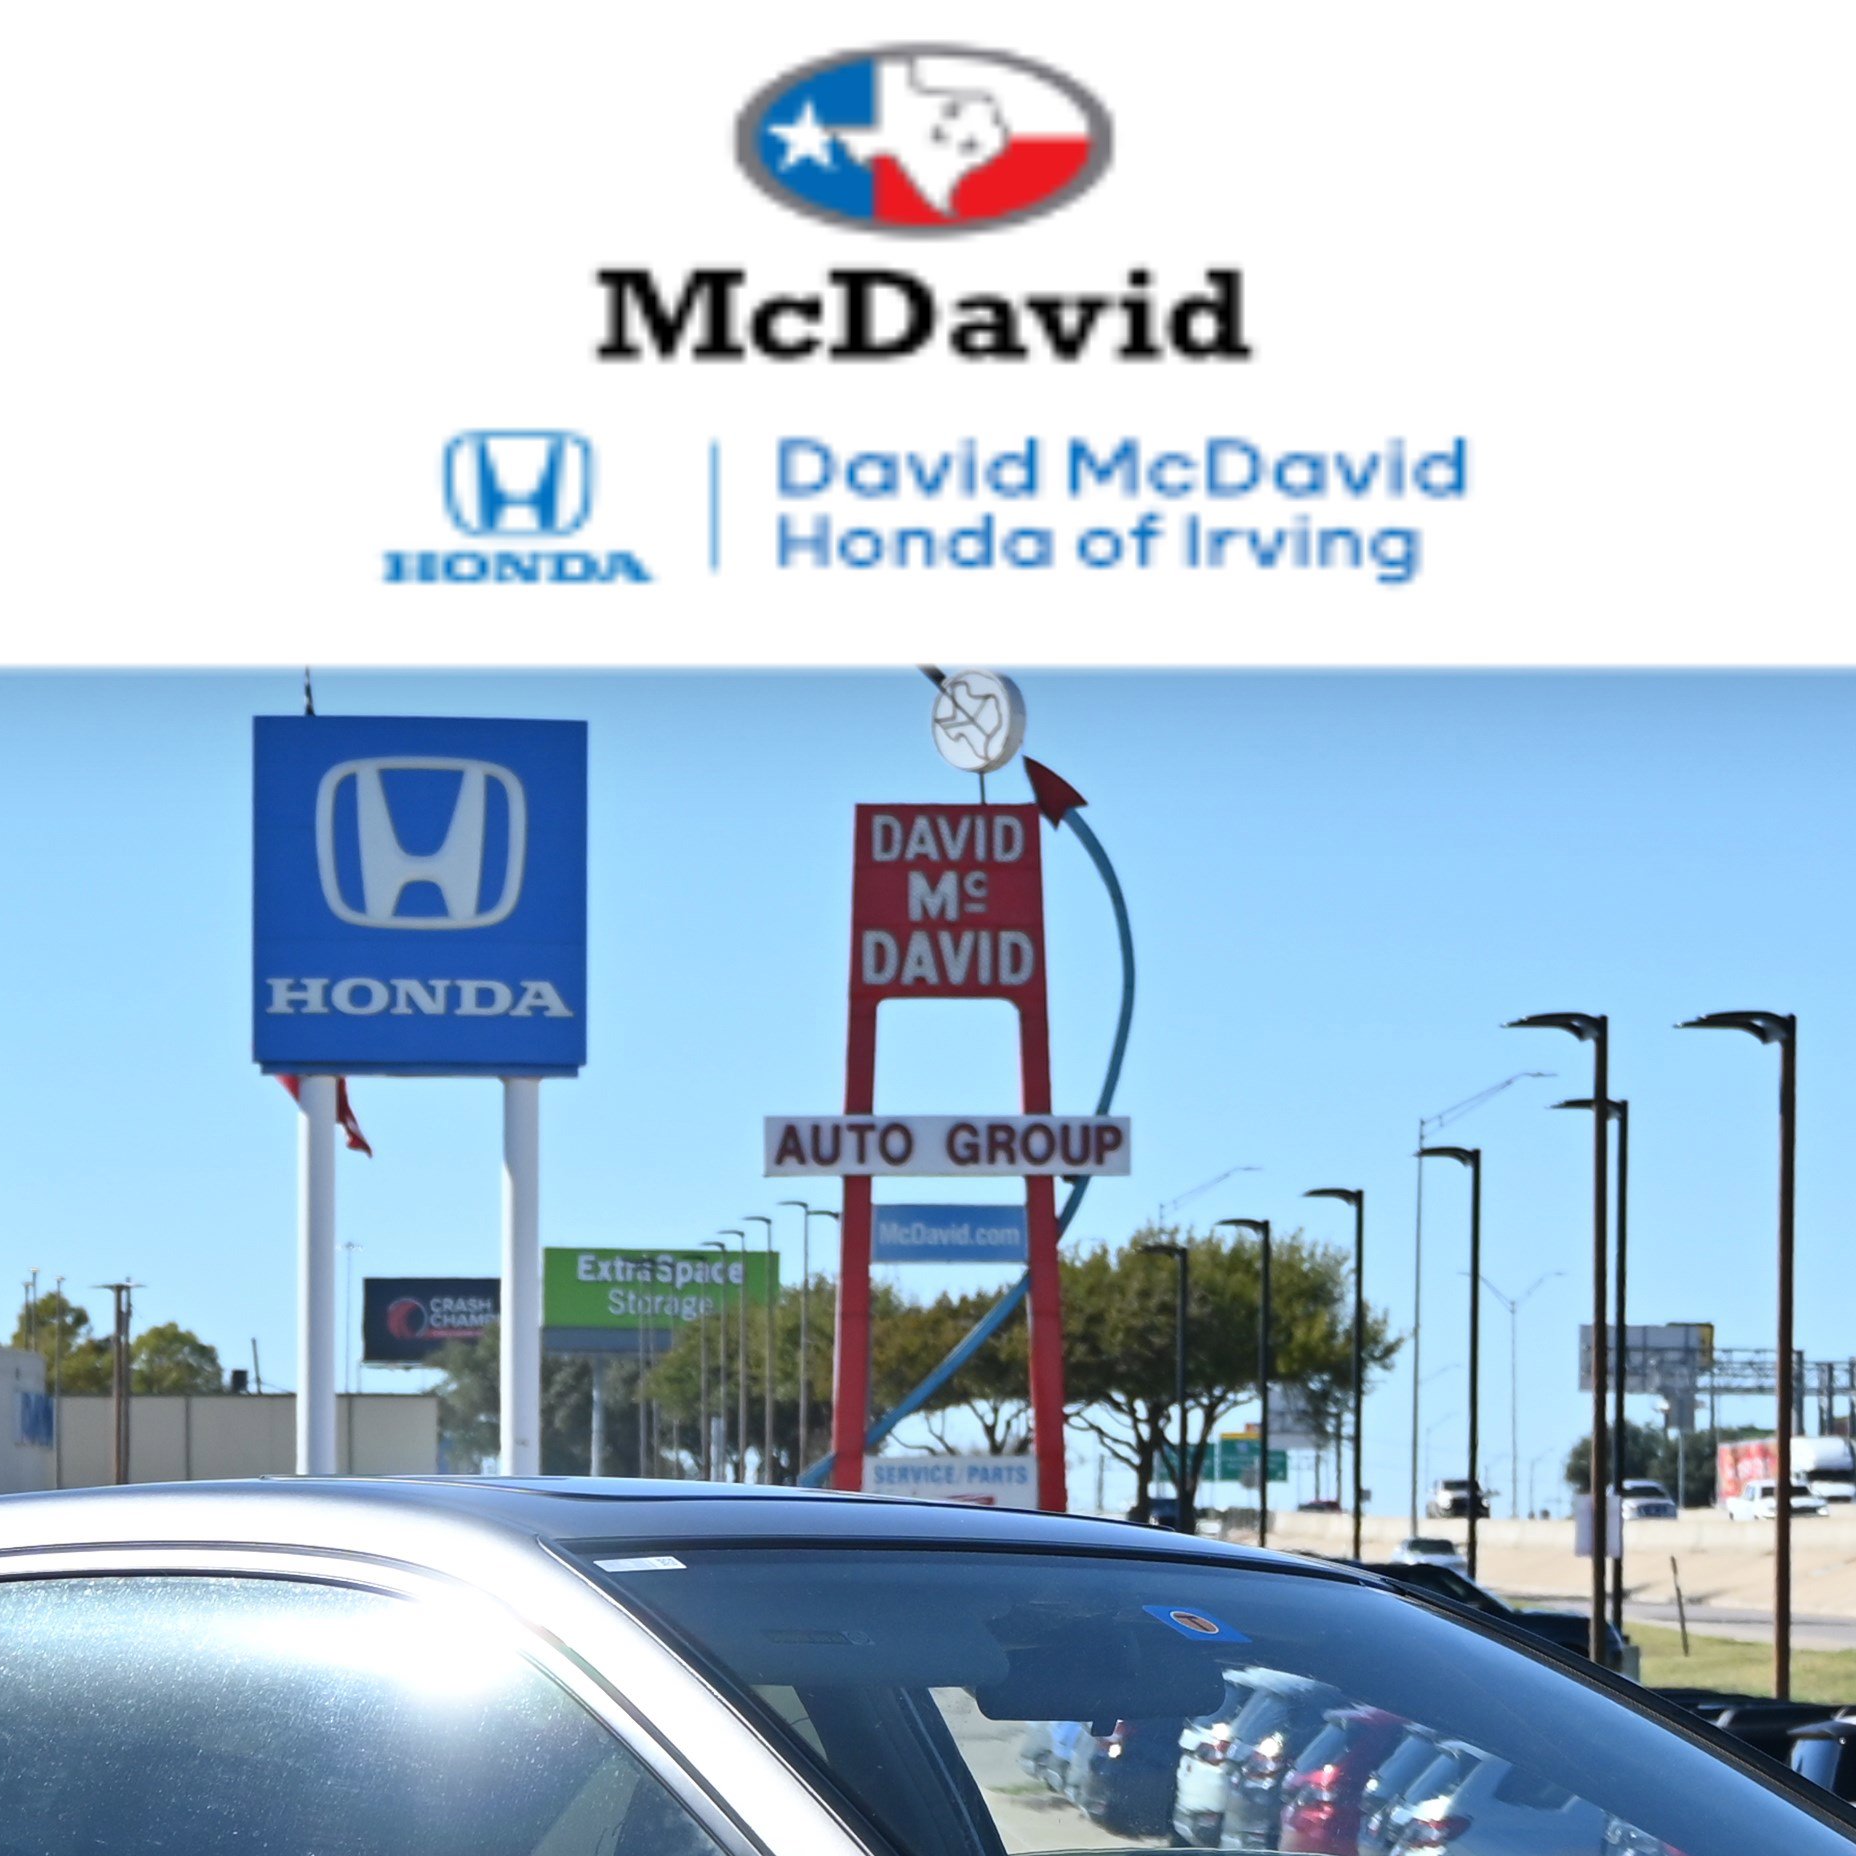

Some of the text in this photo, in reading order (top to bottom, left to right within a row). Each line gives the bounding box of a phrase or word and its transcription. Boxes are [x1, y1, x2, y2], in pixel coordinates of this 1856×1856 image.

[871, 814, 1025, 863] DAVID
[861, 929, 1035, 986] DAVID
[265, 977, 574, 1017] HONDA
[774, 1121, 1125, 1167] AUTO GROUP
[878, 1222, 1020, 1246] McDavid.com
[430, 1297, 492, 1313] CRASH
[430, 1313, 501, 1328] CHAMP
[607, 1288, 715, 1322] Storage
